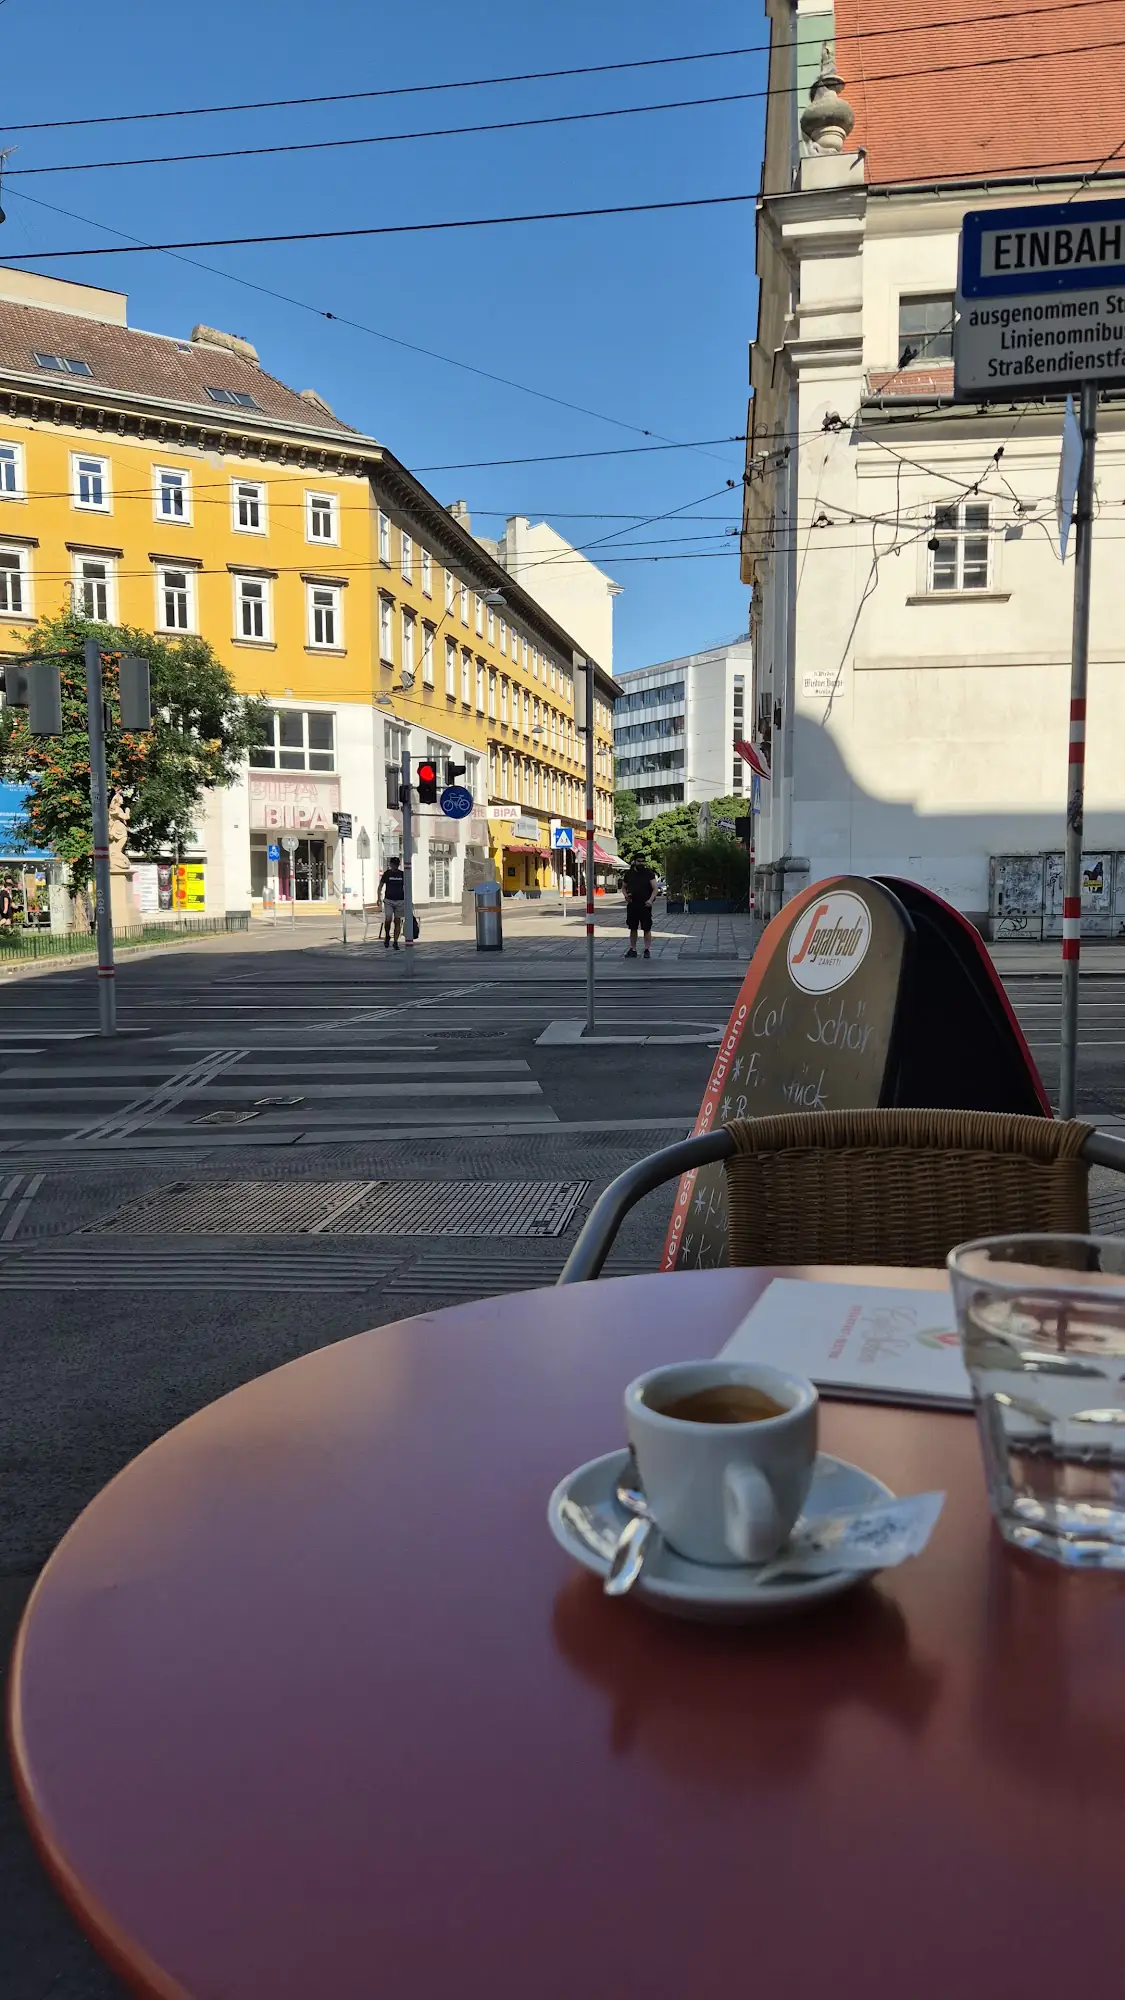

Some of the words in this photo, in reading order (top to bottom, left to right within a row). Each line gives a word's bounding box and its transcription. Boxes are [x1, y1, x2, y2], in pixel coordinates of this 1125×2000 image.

[969, 300, 1099, 328] ausgenommen
[1106, 295, 1125, 315] St
[1000, 322, 1125, 350] Linienomnibu
[264, 805, 329, 829] BIPA
[493, 808, 517, 818] BIPA
[791, 904, 864, 964] Segafredo
[818, 958, 842, 966] ZANETTI
[665, 1214, 682, 1269] vero
[709, 1003, 748, 1095] italiano
